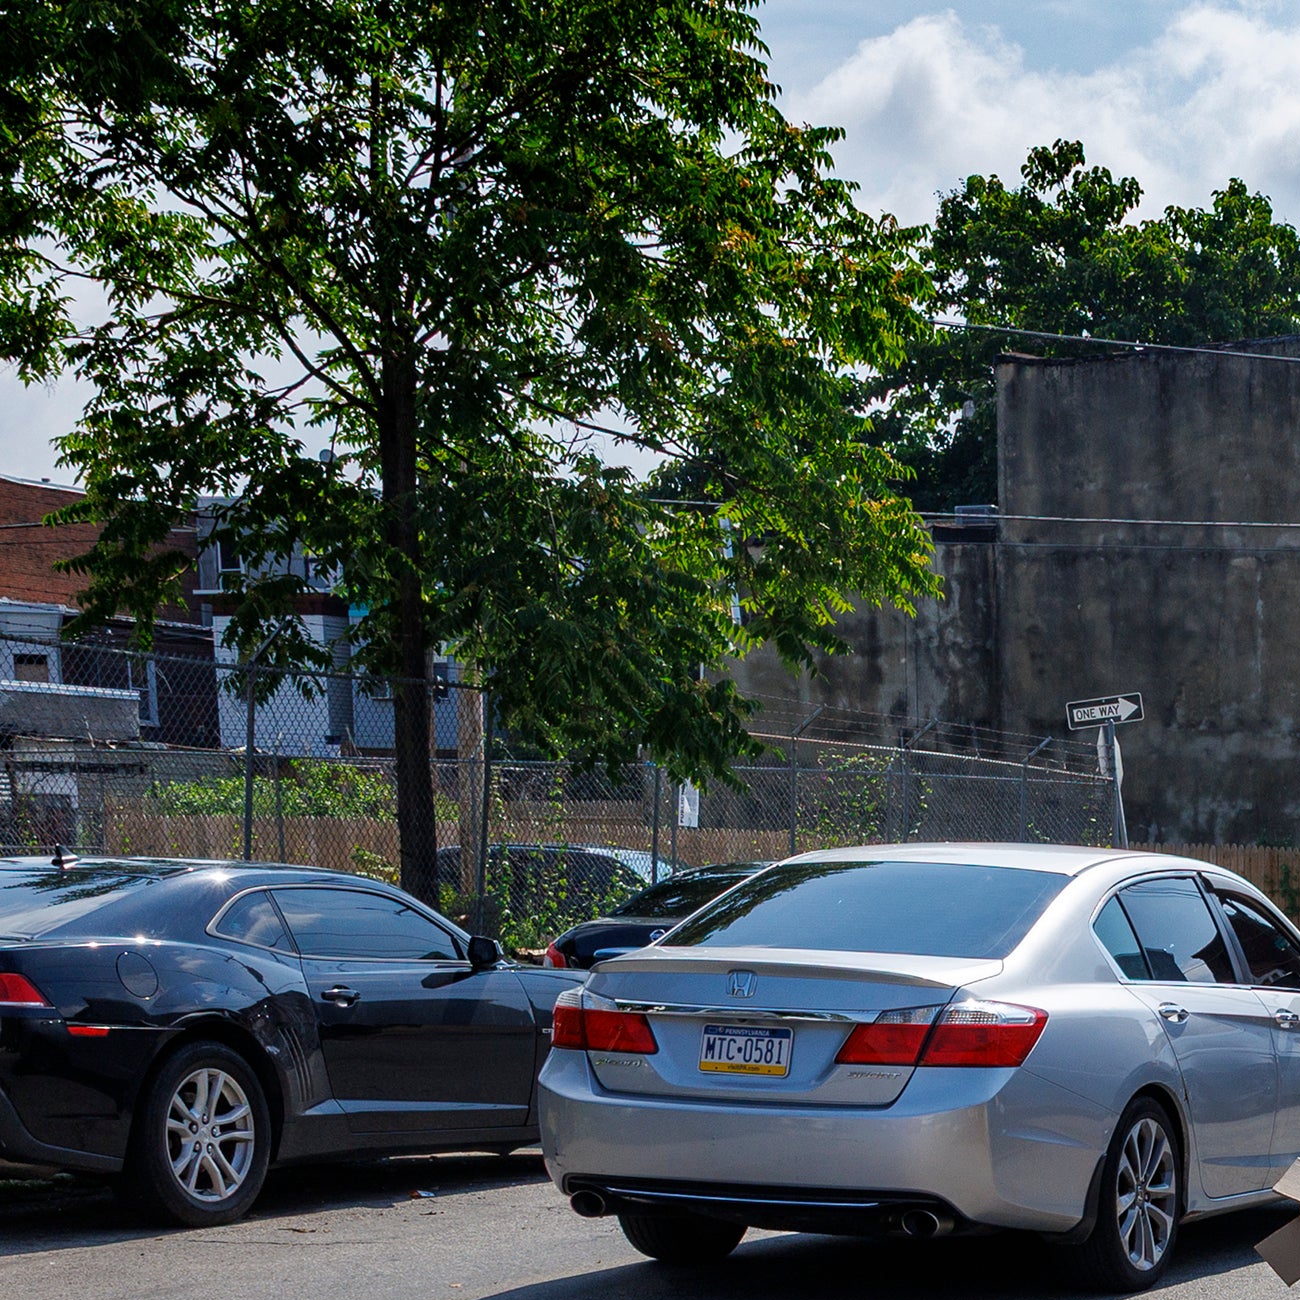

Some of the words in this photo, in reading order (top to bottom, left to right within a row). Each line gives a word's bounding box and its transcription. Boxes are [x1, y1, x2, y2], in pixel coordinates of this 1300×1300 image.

[1076, 708, 1097, 721] ONE
[1098, 704, 1120, 718] WAY
[724, 1028, 770, 1037] PENNSYLVANIA
